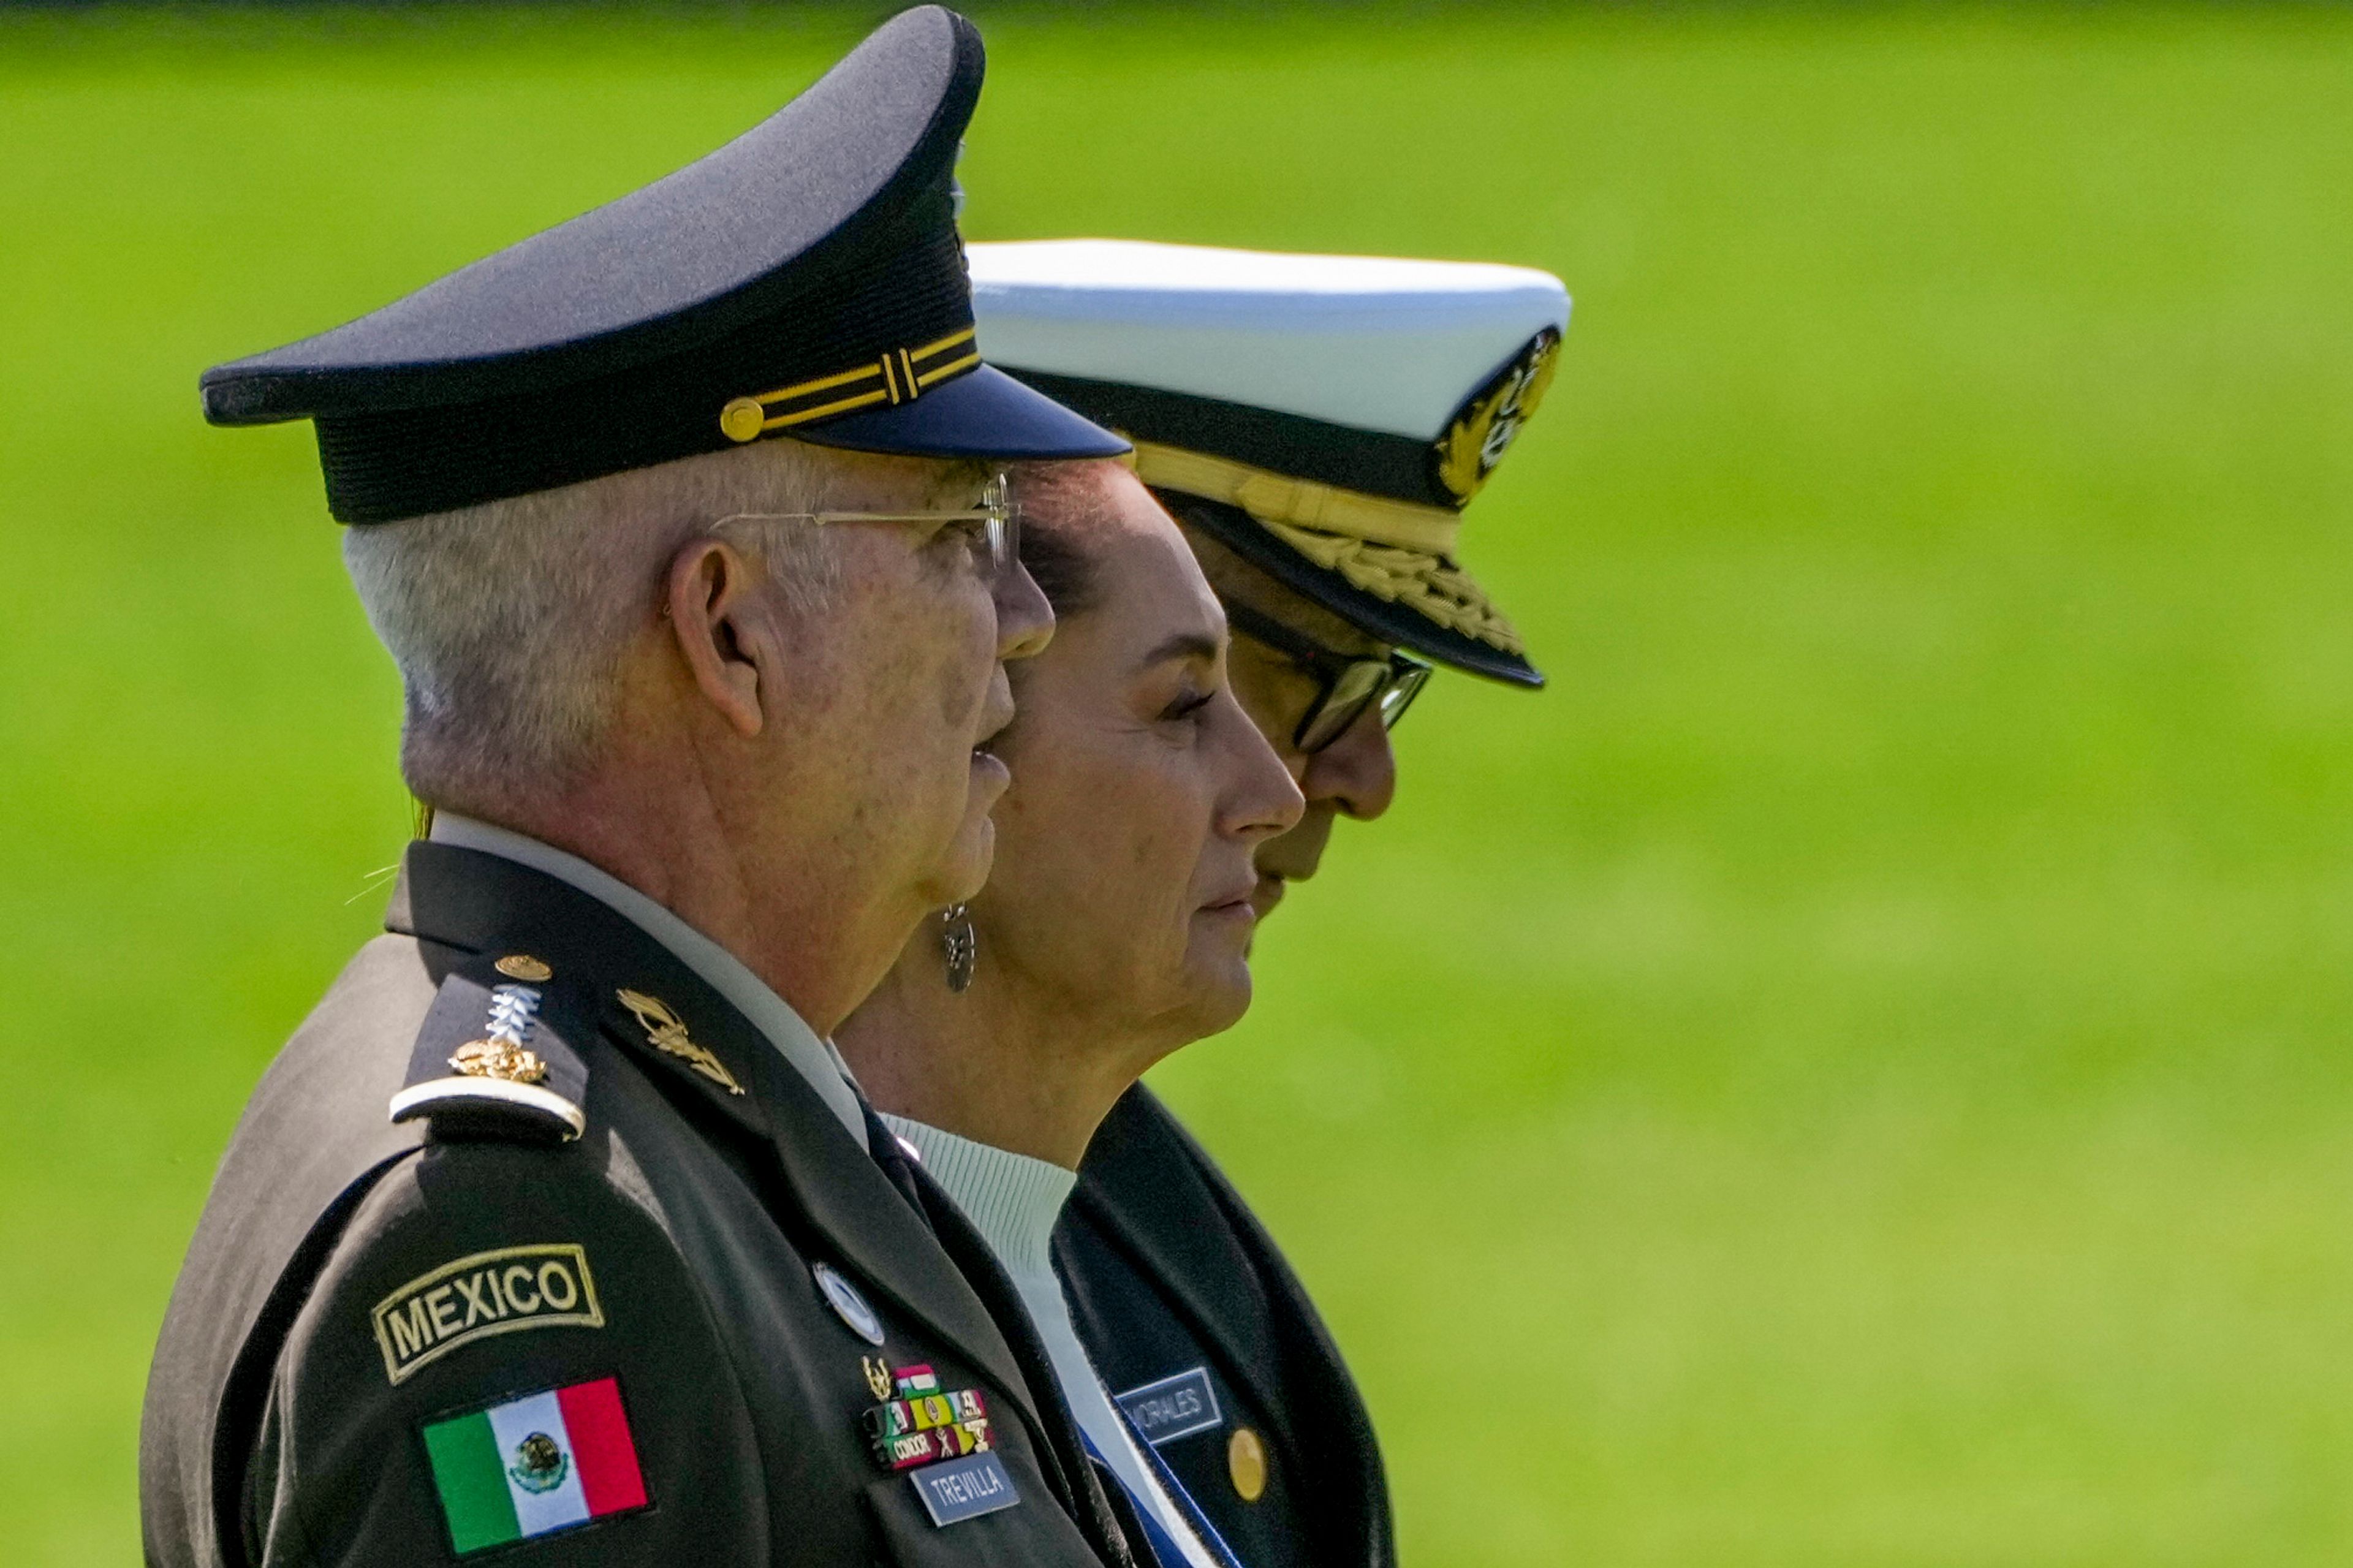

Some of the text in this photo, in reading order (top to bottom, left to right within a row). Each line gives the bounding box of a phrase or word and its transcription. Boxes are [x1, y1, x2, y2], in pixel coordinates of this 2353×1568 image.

[388, 1261, 578, 1360] MEXICO
[893, 1433, 931, 1460] CONDOR
[930, 1465, 1003, 1507] TREVILLA
